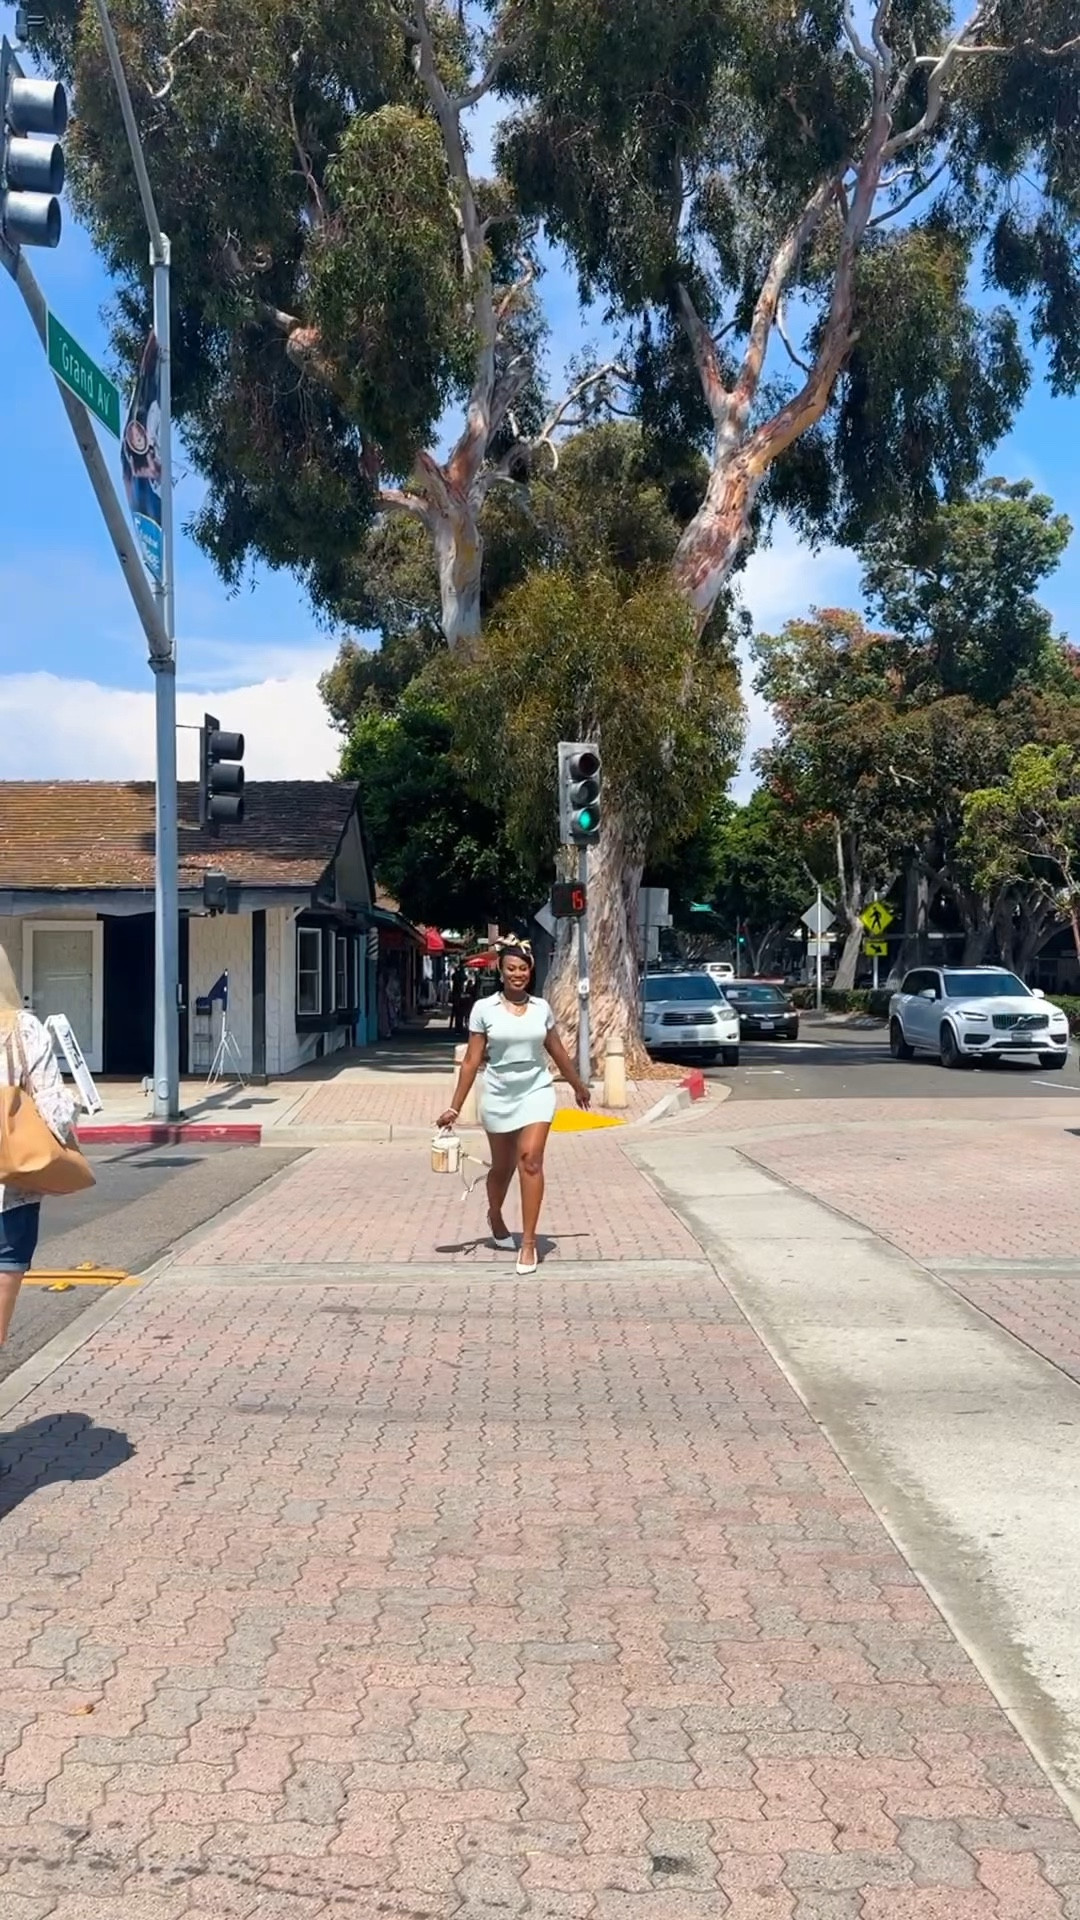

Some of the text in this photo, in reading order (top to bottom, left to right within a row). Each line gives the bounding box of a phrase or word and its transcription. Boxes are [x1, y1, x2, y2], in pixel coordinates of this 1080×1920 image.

[62, 342, 111, 415] Grand Av
[572, 890, 584, 910] 15
